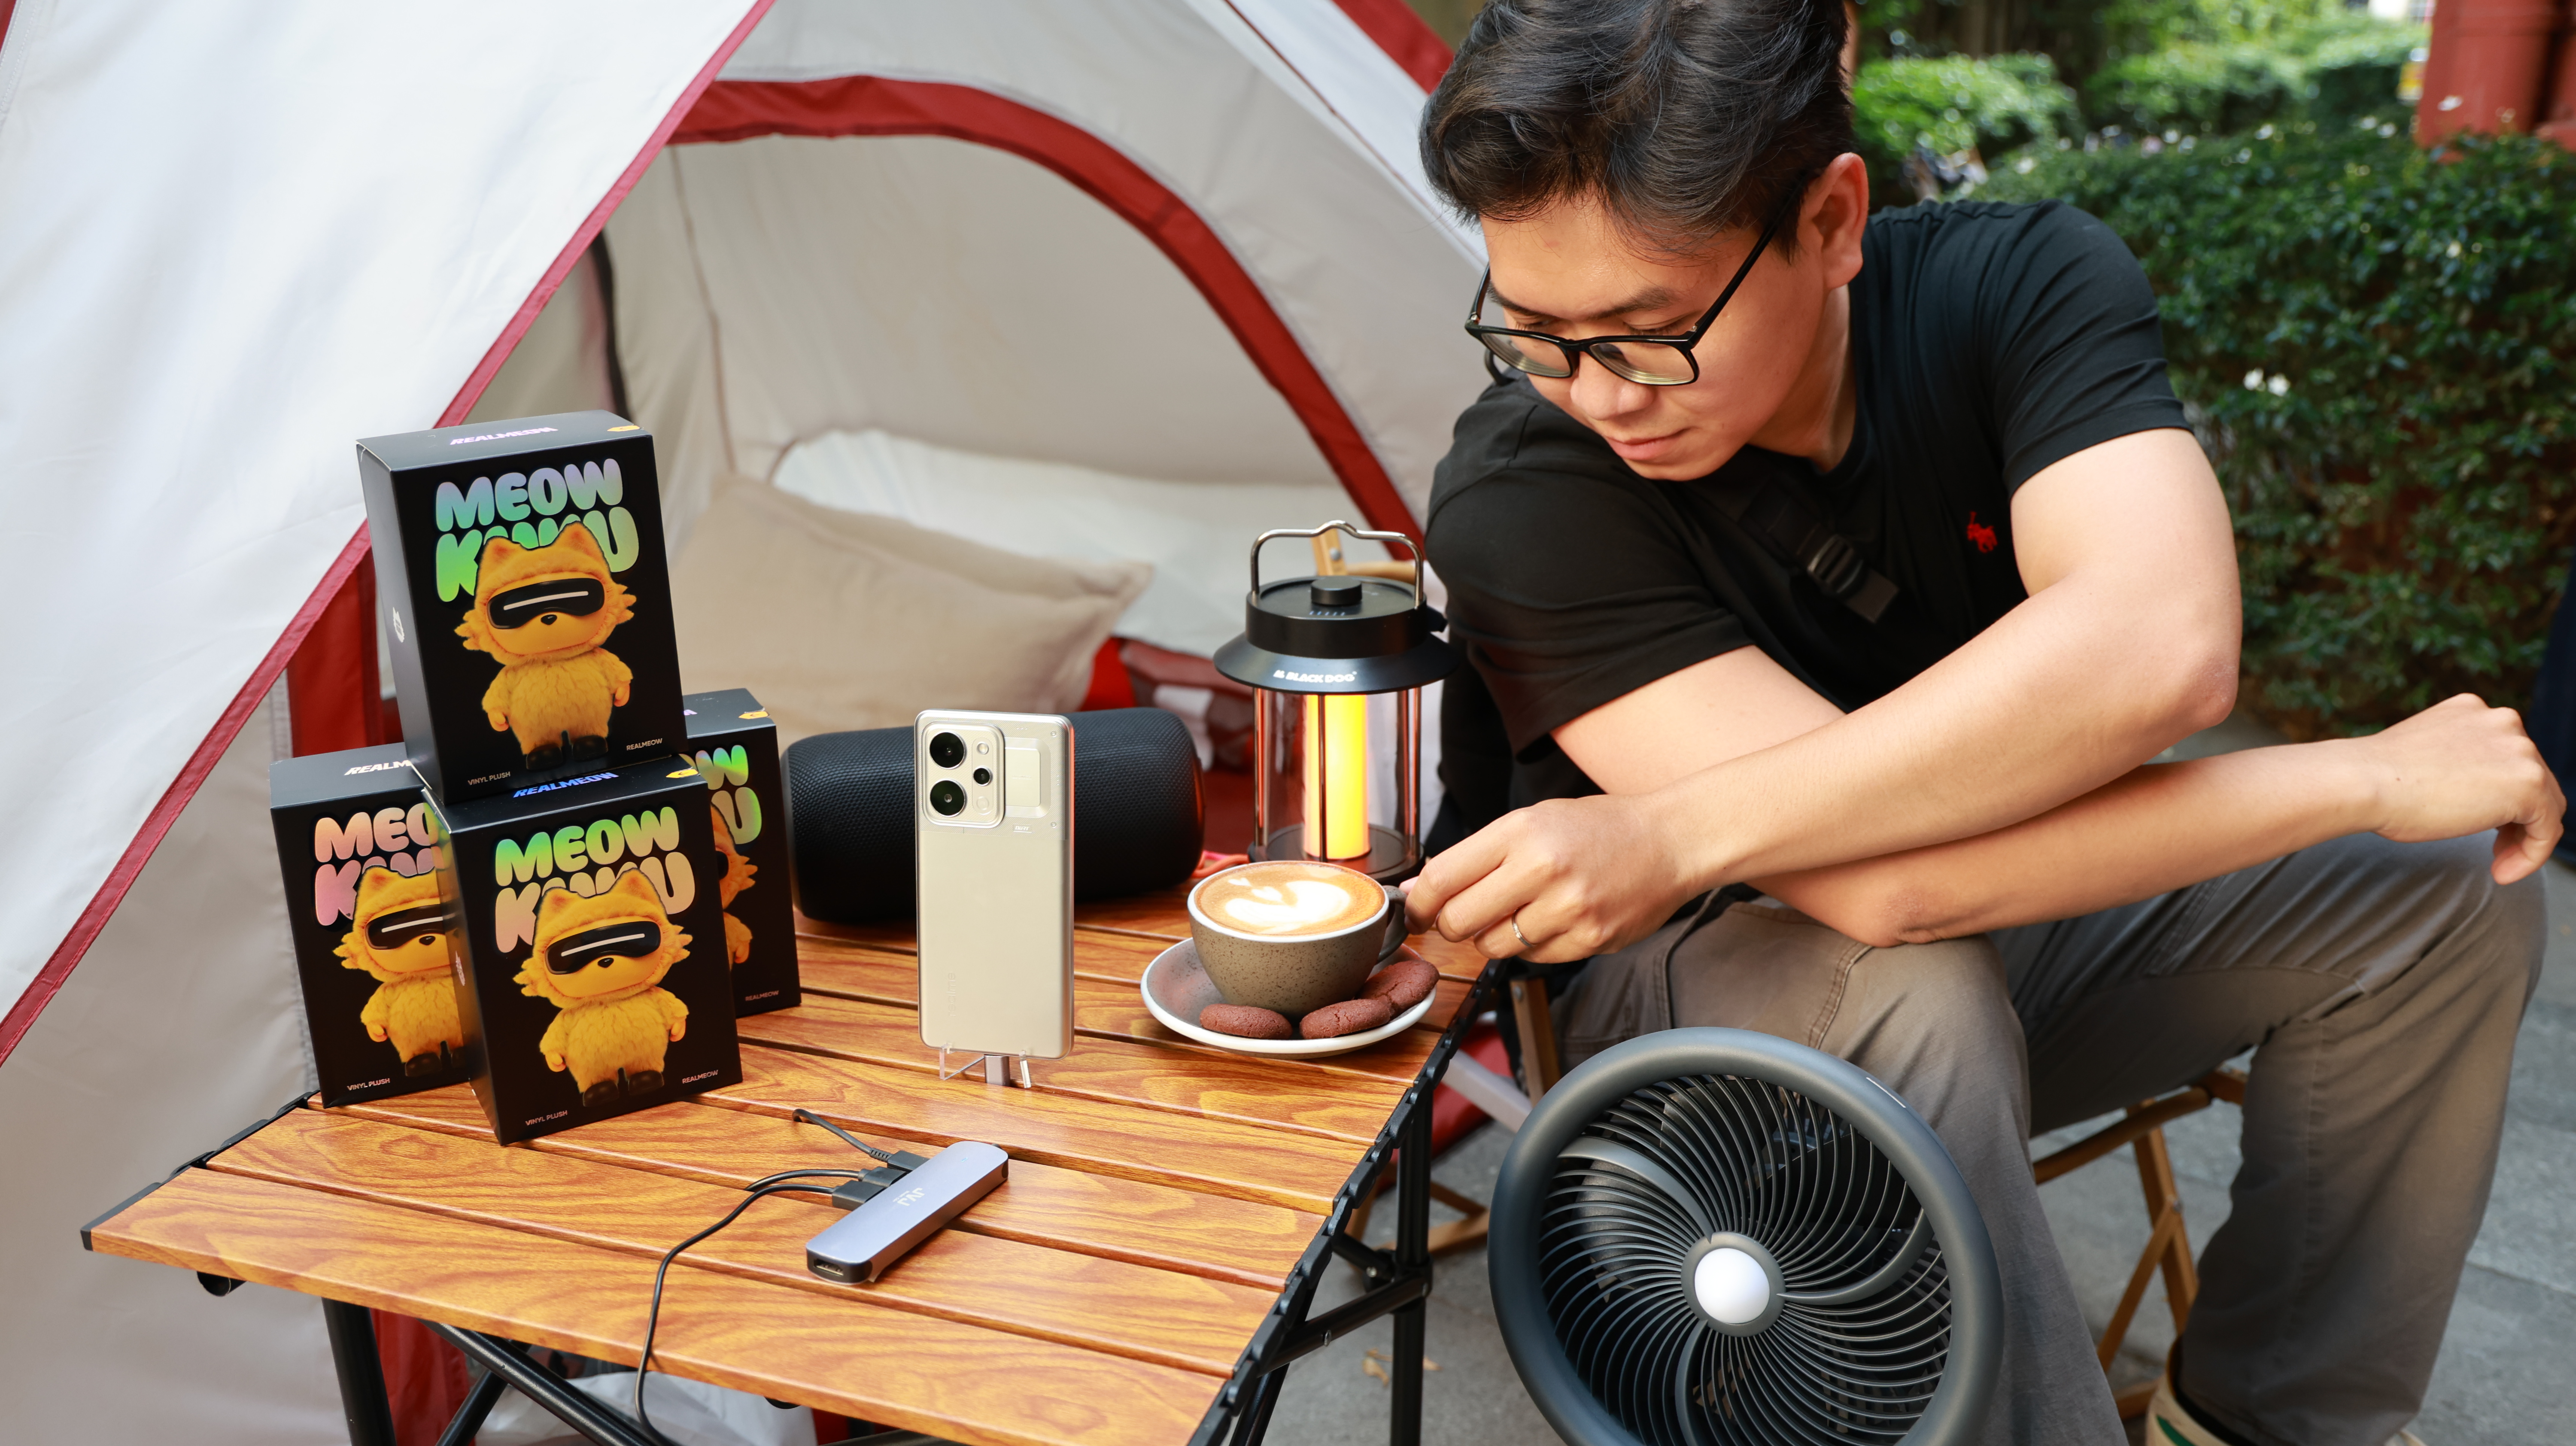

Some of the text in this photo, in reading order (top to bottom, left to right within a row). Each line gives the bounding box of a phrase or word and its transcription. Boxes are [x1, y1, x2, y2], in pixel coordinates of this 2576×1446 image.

[450, 427, 559, 445] REALMEOW
[435, 458, 623, 532] MEOW
[436, 506, 639, 602] KU
[1285, 671, 1355, 683] BLACK DOG
[626, 738, 662, 750] REALMEOW
[344, 759, 412, 775] REALM
[468, 771, 511, 786] VINYL PLUSH
[513, 772, 620, 798] REALMEOW
[314, 802, 431, 863] MEO
[495, 806, 680, 887] MEOW
[495, 851, 696, 953] KU
[745, 990, 779, 1002] REALMEOW
[946, 971, 956, 1018] realme
[346, 1078, 390, 1091] VINYL PLUSH
[682, 1069, 719, 1084] REALMEOW
[525, 1110, 568, 1126] VINYL PLUSH
